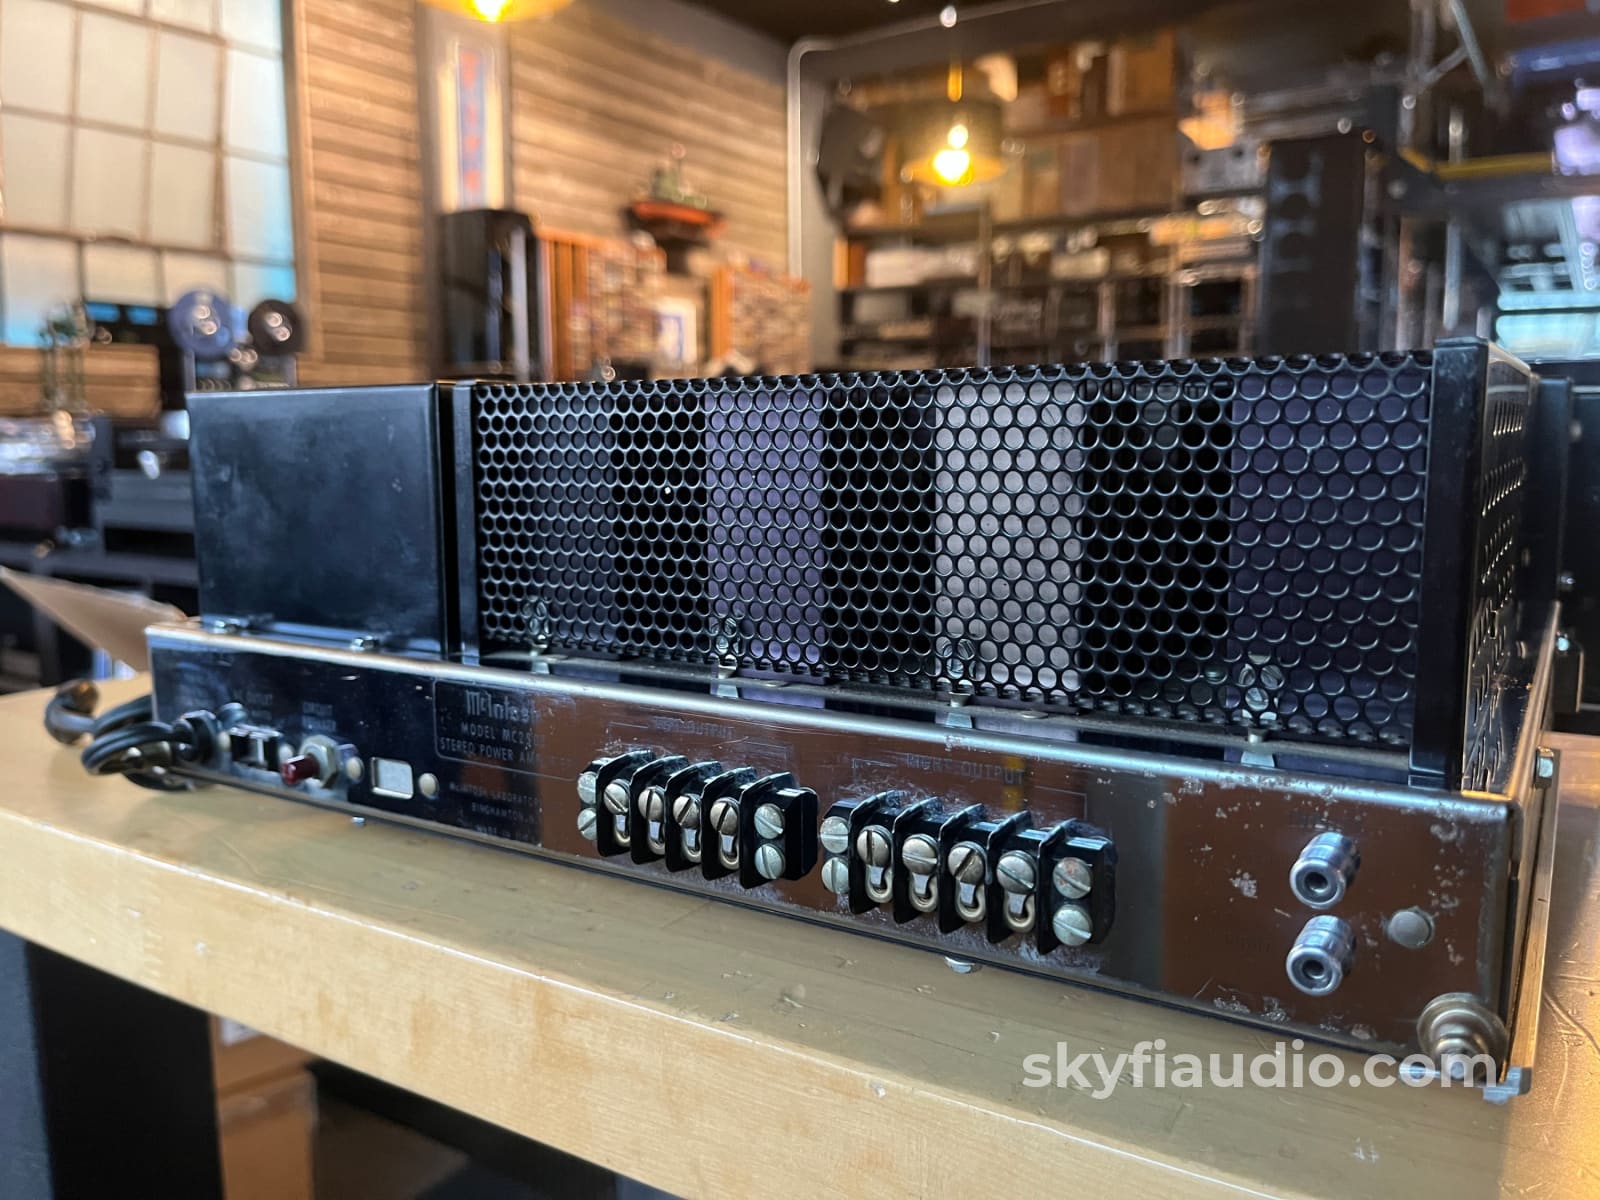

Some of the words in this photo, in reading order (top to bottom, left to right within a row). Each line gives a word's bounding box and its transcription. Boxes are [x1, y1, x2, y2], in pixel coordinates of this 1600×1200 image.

[460, 721, 496, 740] MODEL
[440, 736, 473, 755] STEREO
[475, 744, 514, 761] POWER
[960, 760, 1024, 785] OUTPUT
